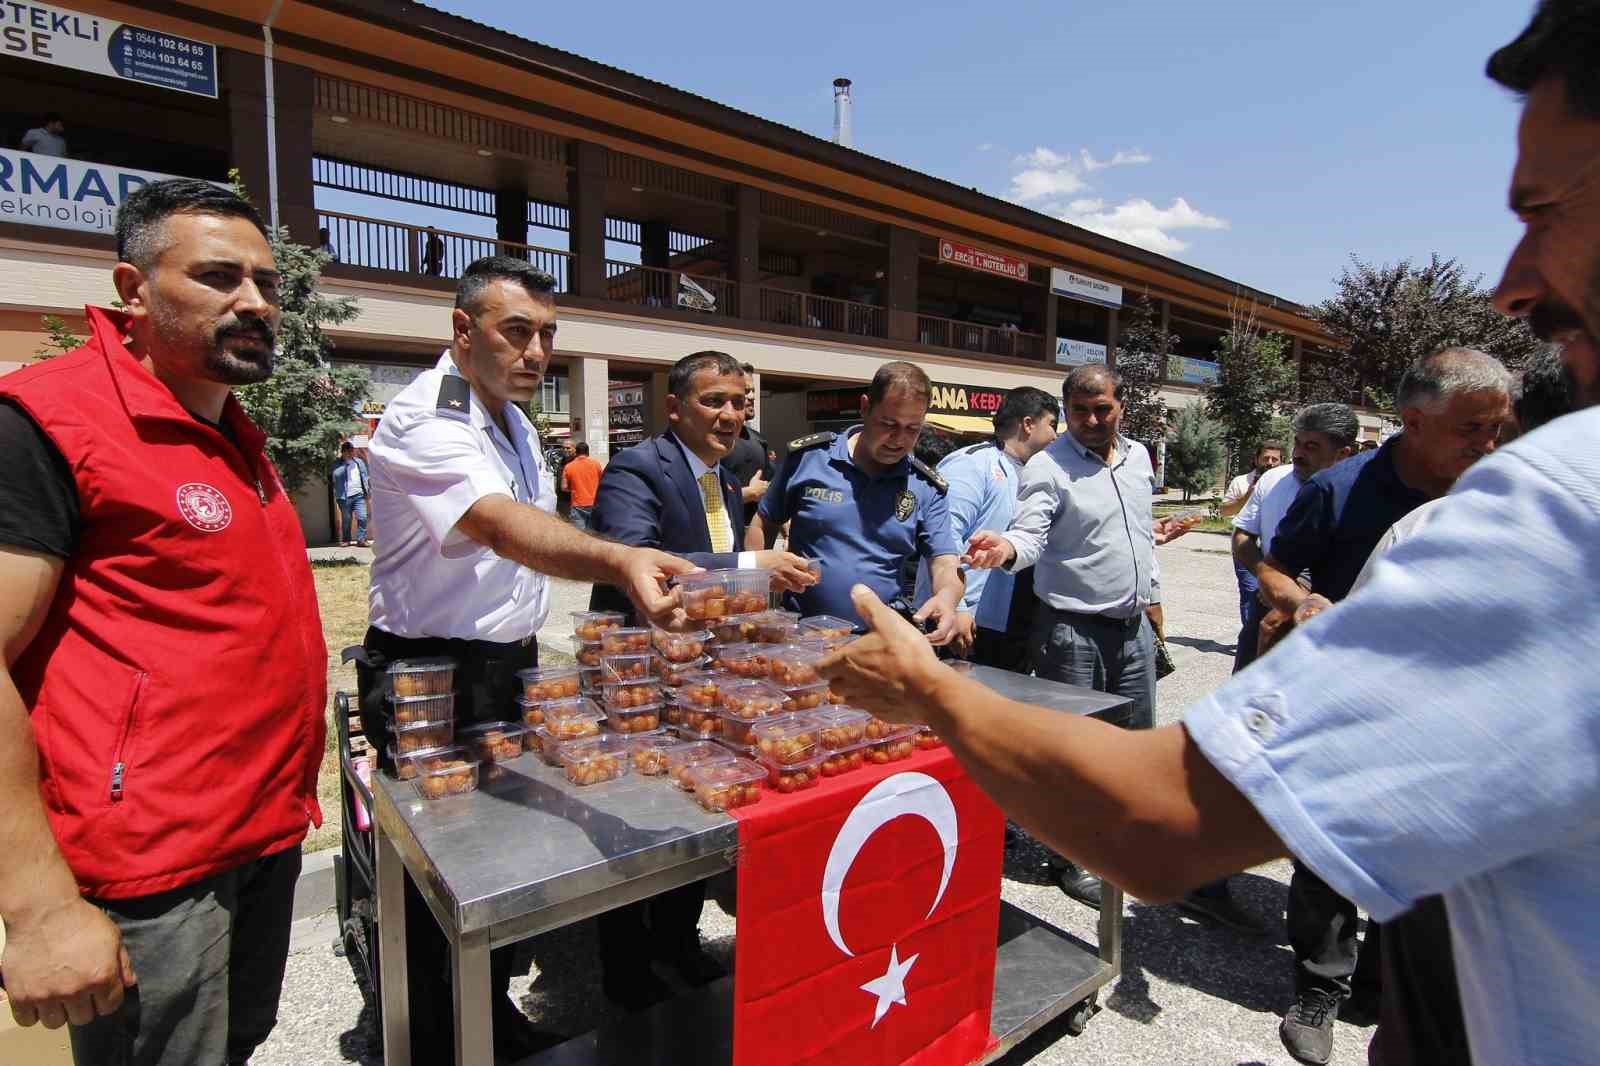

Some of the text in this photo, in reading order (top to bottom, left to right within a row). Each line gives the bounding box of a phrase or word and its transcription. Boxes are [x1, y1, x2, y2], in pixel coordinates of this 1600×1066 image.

[0, 0, 99, 42] TEKLi
[3, 26, 52, 58] SE
[136, 32, 204, 56] 0544 102 64 65
[136, 48, 157, 60] 0544
[158, 53, 175, 65] 103
[177, 57, 190, 68] 64
[191, 60, 203, 71] 65
